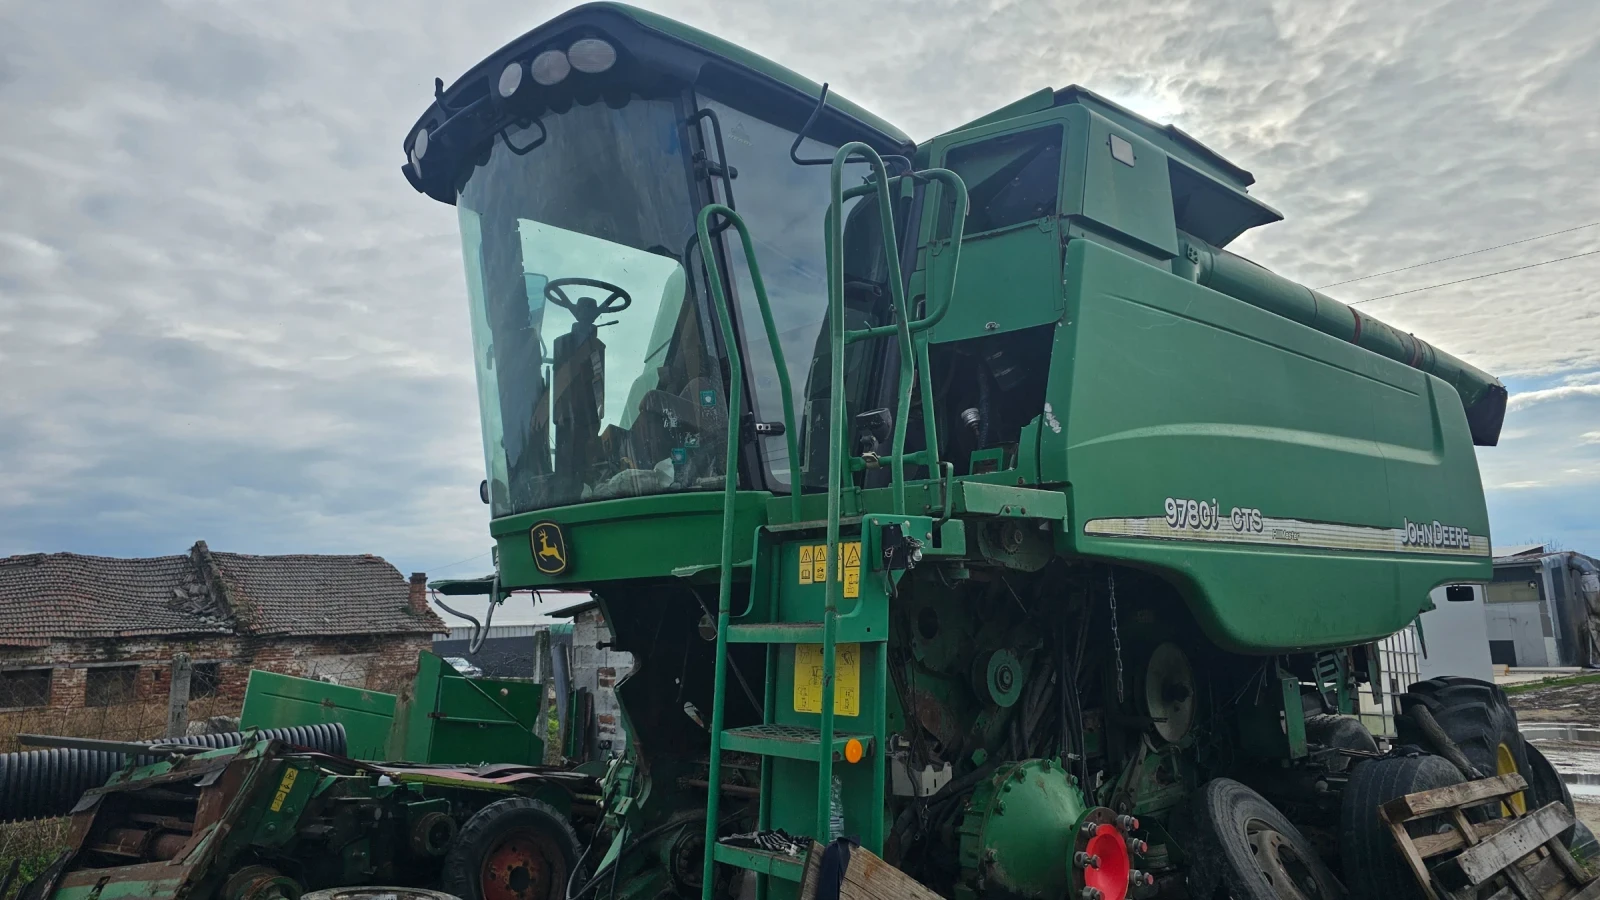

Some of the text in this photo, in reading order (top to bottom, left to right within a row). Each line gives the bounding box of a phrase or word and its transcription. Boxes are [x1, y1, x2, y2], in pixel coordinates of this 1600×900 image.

[1164, 497, 1264, 534] 9780i CTS
[1401, 516, 1470, 549] JOHN DEERE
